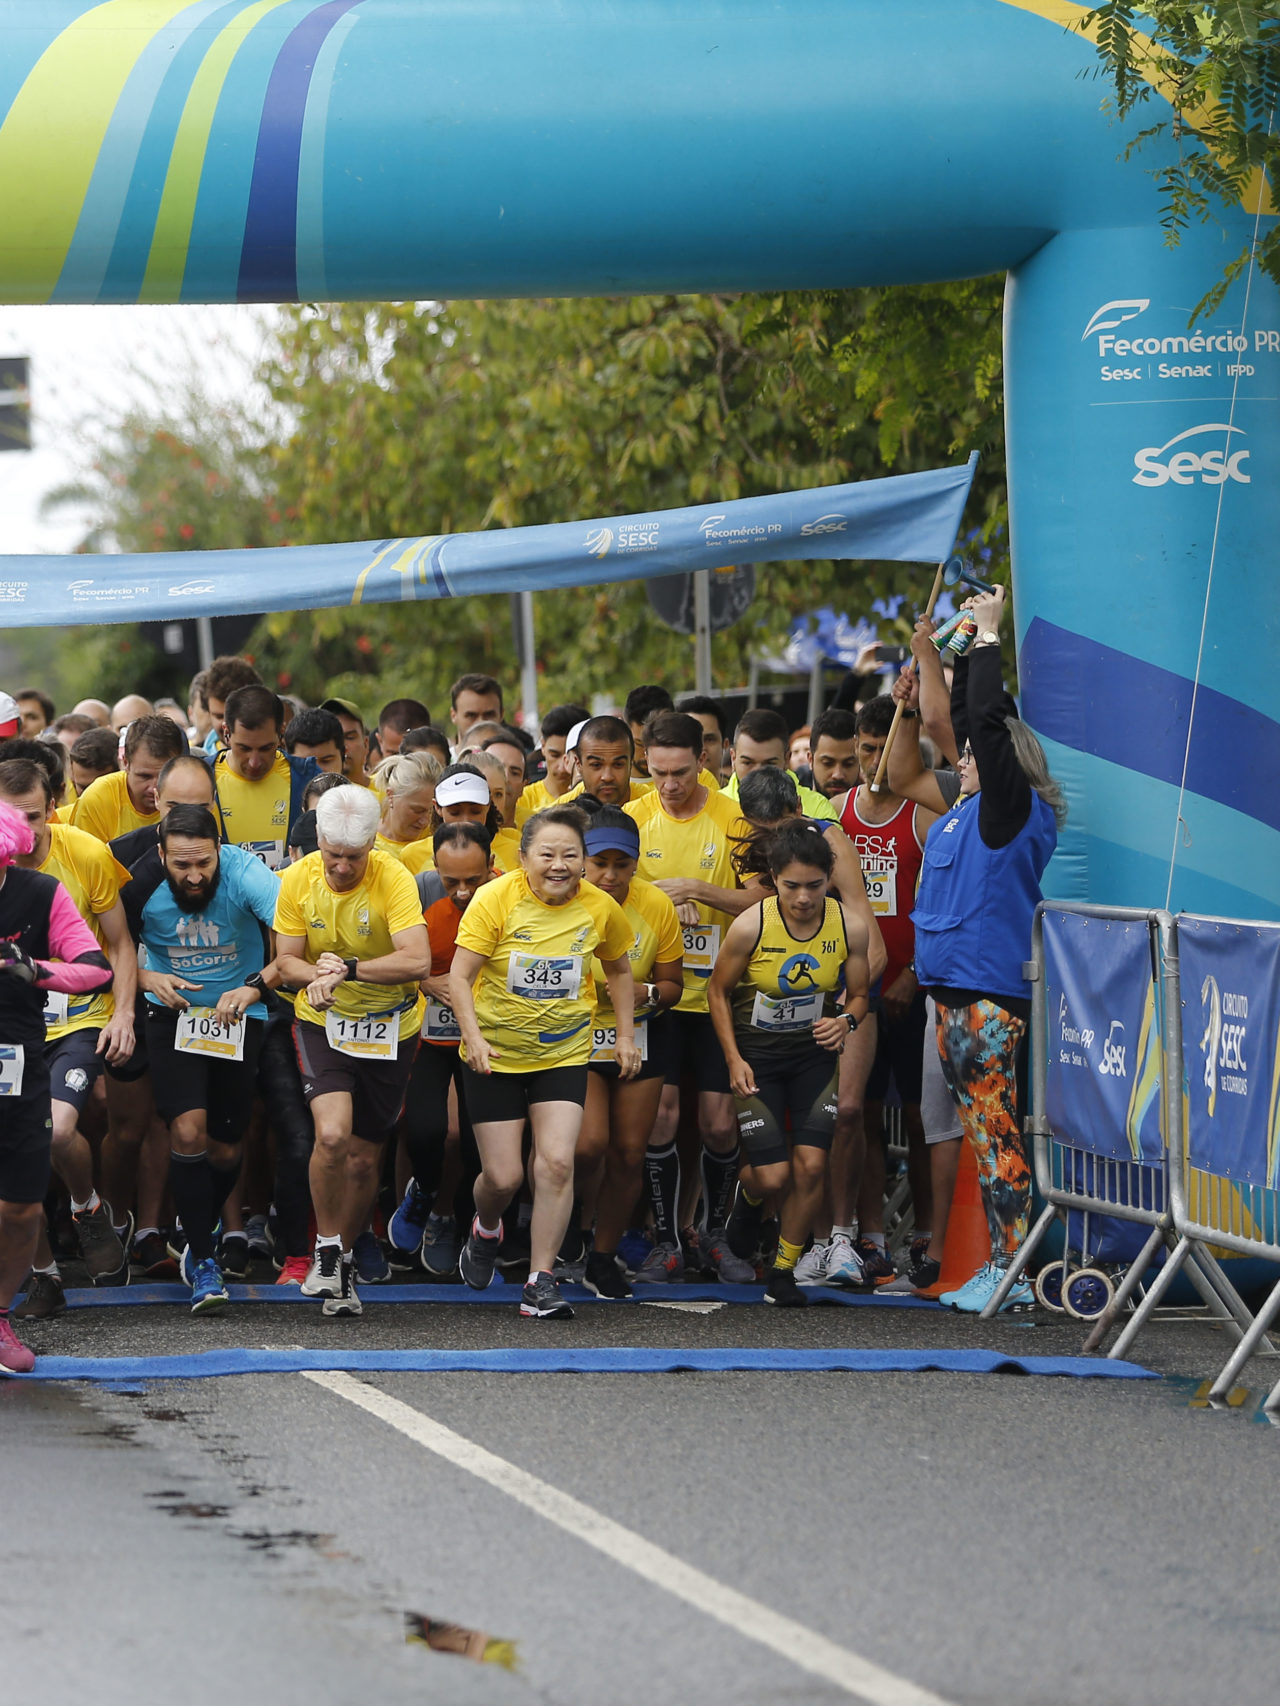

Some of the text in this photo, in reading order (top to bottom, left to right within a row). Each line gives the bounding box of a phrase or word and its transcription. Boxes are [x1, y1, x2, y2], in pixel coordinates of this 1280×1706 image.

[1099, 330, 1247, 357] Fecomércio
[1101, 363, 1255, 381] Sesc Senac IFPD
[1132, 438, 1252, 487] Sesc
[618, 522, 660, 533] CIRCUITO
[705, 523, 783, 539] Fecomércio PR
[800, 518, 848, 537] Sesc
[618, 531, 659, 548] SESC
[73, 586, 149, 596] Fecomércio PR
[167, 582, 216, 597] Sesc
[240, 842, 255, 851] 6k
[646, 850, 662, 859] Sesc
[513, 931, 532, 942] Sesc
[683, 934, 707, 951] 30
[171, 953, 238, 969] SóCorro
[626, 951, 641, 959] ESC
[537, 960, 552, 970] 6k
[523, 968, 562, 985] 343
[772, 1007, 796, 1021] 41
[187, 1017, 231, 1040] 1031
[337, 1019, 387, 1040] 1112
[1081, 1028, 1095, 1049] PR
[1220, 1022, 1247, 1072] SESC
[1098, 1031, 1127, 1078] Sesc
[646, 1161, 667, 1231] Kalenji
